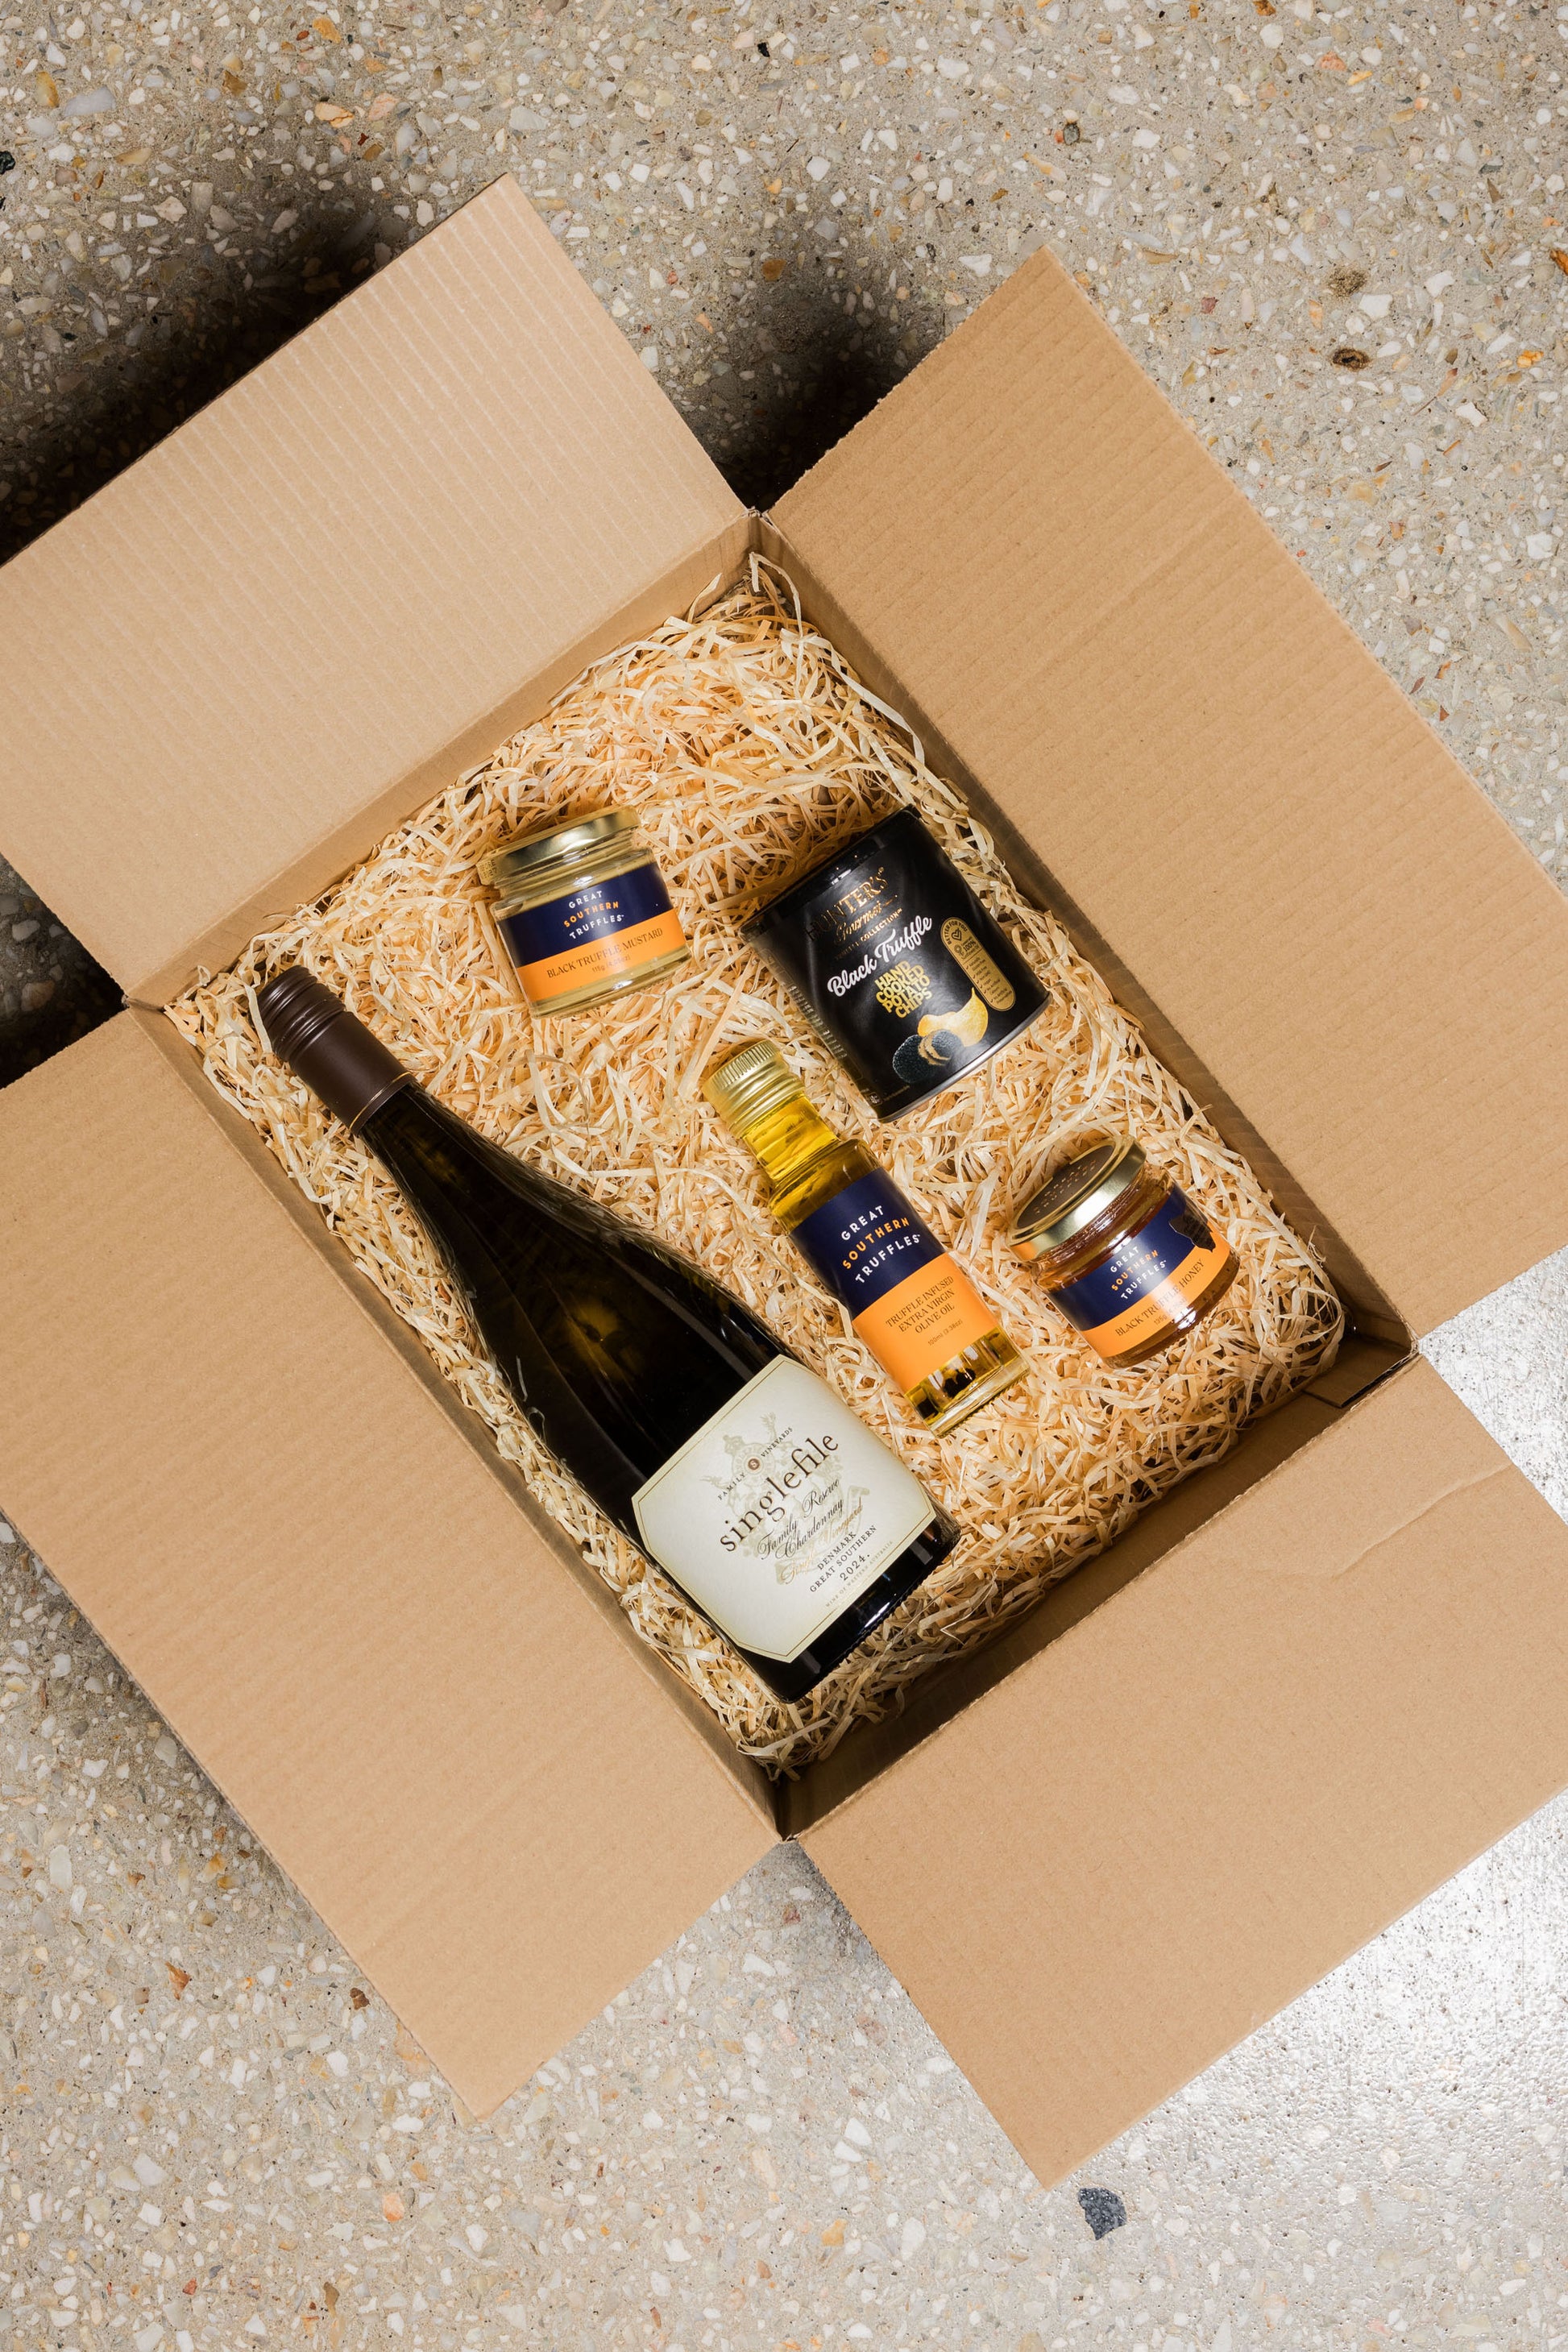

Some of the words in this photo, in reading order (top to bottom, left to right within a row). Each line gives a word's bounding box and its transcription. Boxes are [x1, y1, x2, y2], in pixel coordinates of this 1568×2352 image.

[564, 901, 619, 927] SOUTHERN
[569, 890, 602, 909] GREAT
[958, 922, 968, 931] YOU
[546, 960, 575, 978] BLACK
[575, 944, 622, 967] TRUFFLE
[623, 927, 663, 951] MUSTARD
[828, 954, 877, 998] Black
[874, 915, 932, 962] Truffle
[874, 960, 911, 990] HAND
[876, 964, 924, 1003] COOKED
[881, 974, 931, 1013] POTATO
[895, 988, 932, 1018] CHIPS
[841, 1205, 884, 1241] GREAT
[842, 1217, 910, 1270] SOUTHERN
[1110, 1247, 1139, 1272] GREAT
[1111, 1250, 1159, 1291] SOUTHERN
[886, 1297, 924, 1328] TRUFFLE
[922, 1276, 954, 1300] INFUSED
[898, 1307, 927, 1333] EXTRA
[927, 1288, 956, 1311] VIRGIN
[915, 1311, 941, 1334] OLIVE
[940, 1302, 956, 1317] OIL
[1114, 1316, 1143, 1337] BLACK
[1178, 1259, 1205, 1288] HONEY
[718, 1472, 746, 1500] FAMILY
[761, 1427, 793, 1458] VINEYARDS
[720, 1435, 839, 1552] singlefile
[757, 1513, 799, 1560] Family
[802, 1479, 840, 1518] Reserve
[775, 1499, 844, 1559] Chardonnay
[810, 1567, 836, 1593] GREAT
[836, 1525, 877, 1567] SOUTHERN
[817, 1532, 857, 1570] DENMARK
